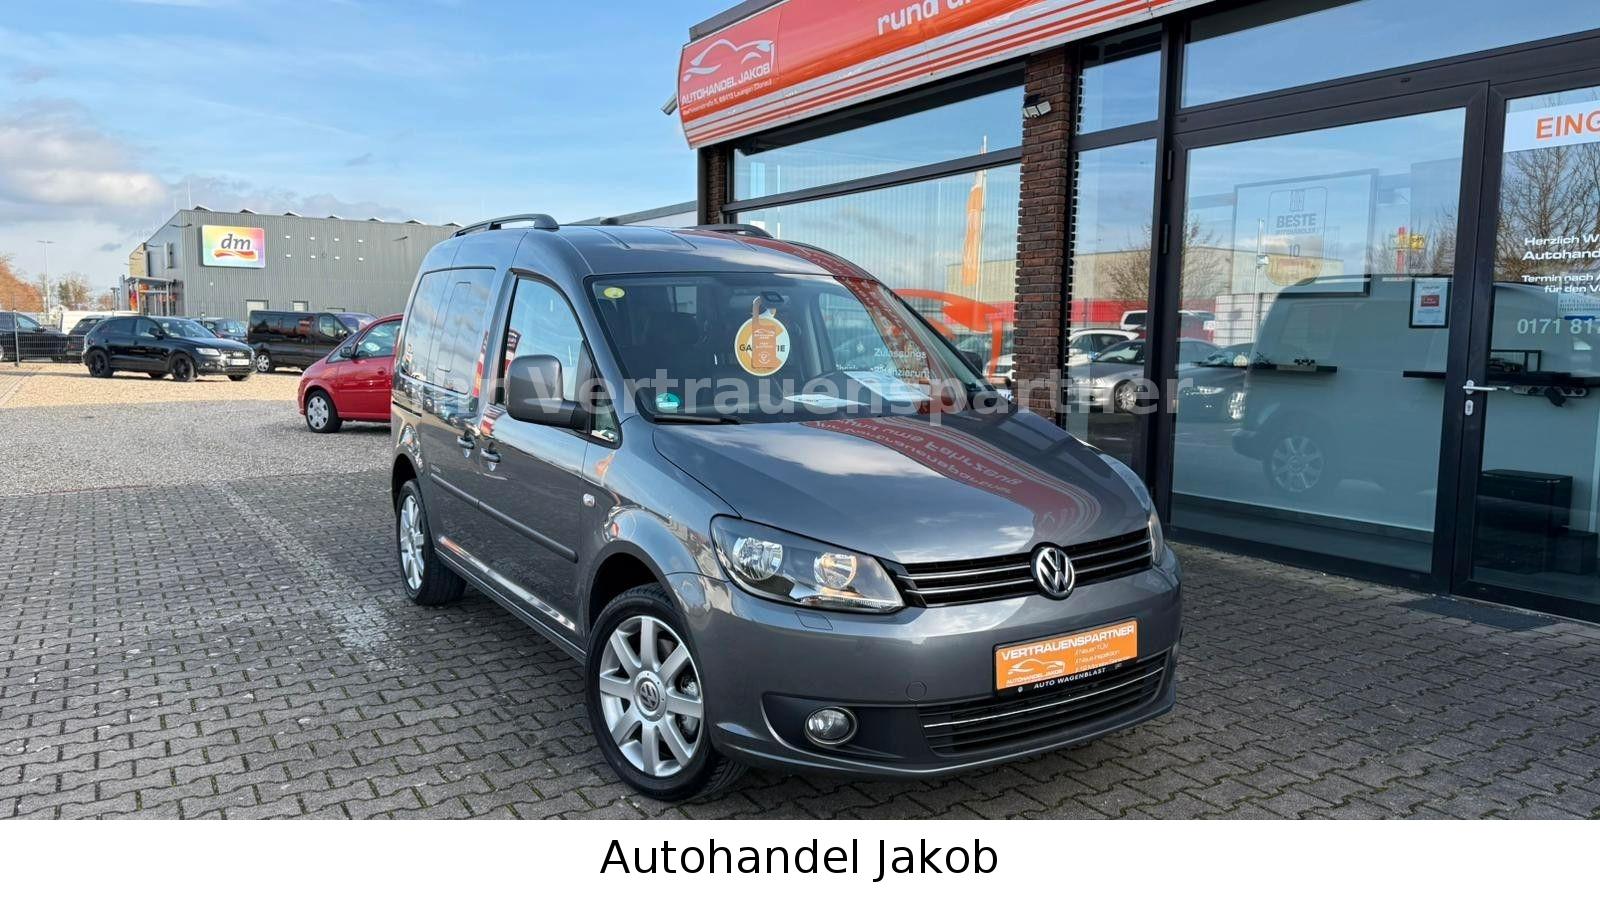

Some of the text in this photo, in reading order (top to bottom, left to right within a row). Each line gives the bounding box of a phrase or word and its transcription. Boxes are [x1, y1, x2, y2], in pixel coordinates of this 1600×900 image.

[681, 63, 771, 105] AUTOHANDEL JAKOB
[1276, 213, 1317, 228] BESTE
[221, 233, 251, 250] dm
[1524, 236, 1580, 246] Herzlich
[1521, 275, 1561, 283] Termin
[1564, 274, 1594, 284] nach
[1544, 285, 1562, 293] für
[1564, 285, 1587, 293] den
[1517, 319, 1561, 335] 0171
[739, 343, 785, 353] GAIE
[1001, 624, 1135, 661] VERTRAUENSPARTNER
[1033, 679, 1055, 690] AUTO
[1057, 667, 1107, 684] WAGENBLAST
